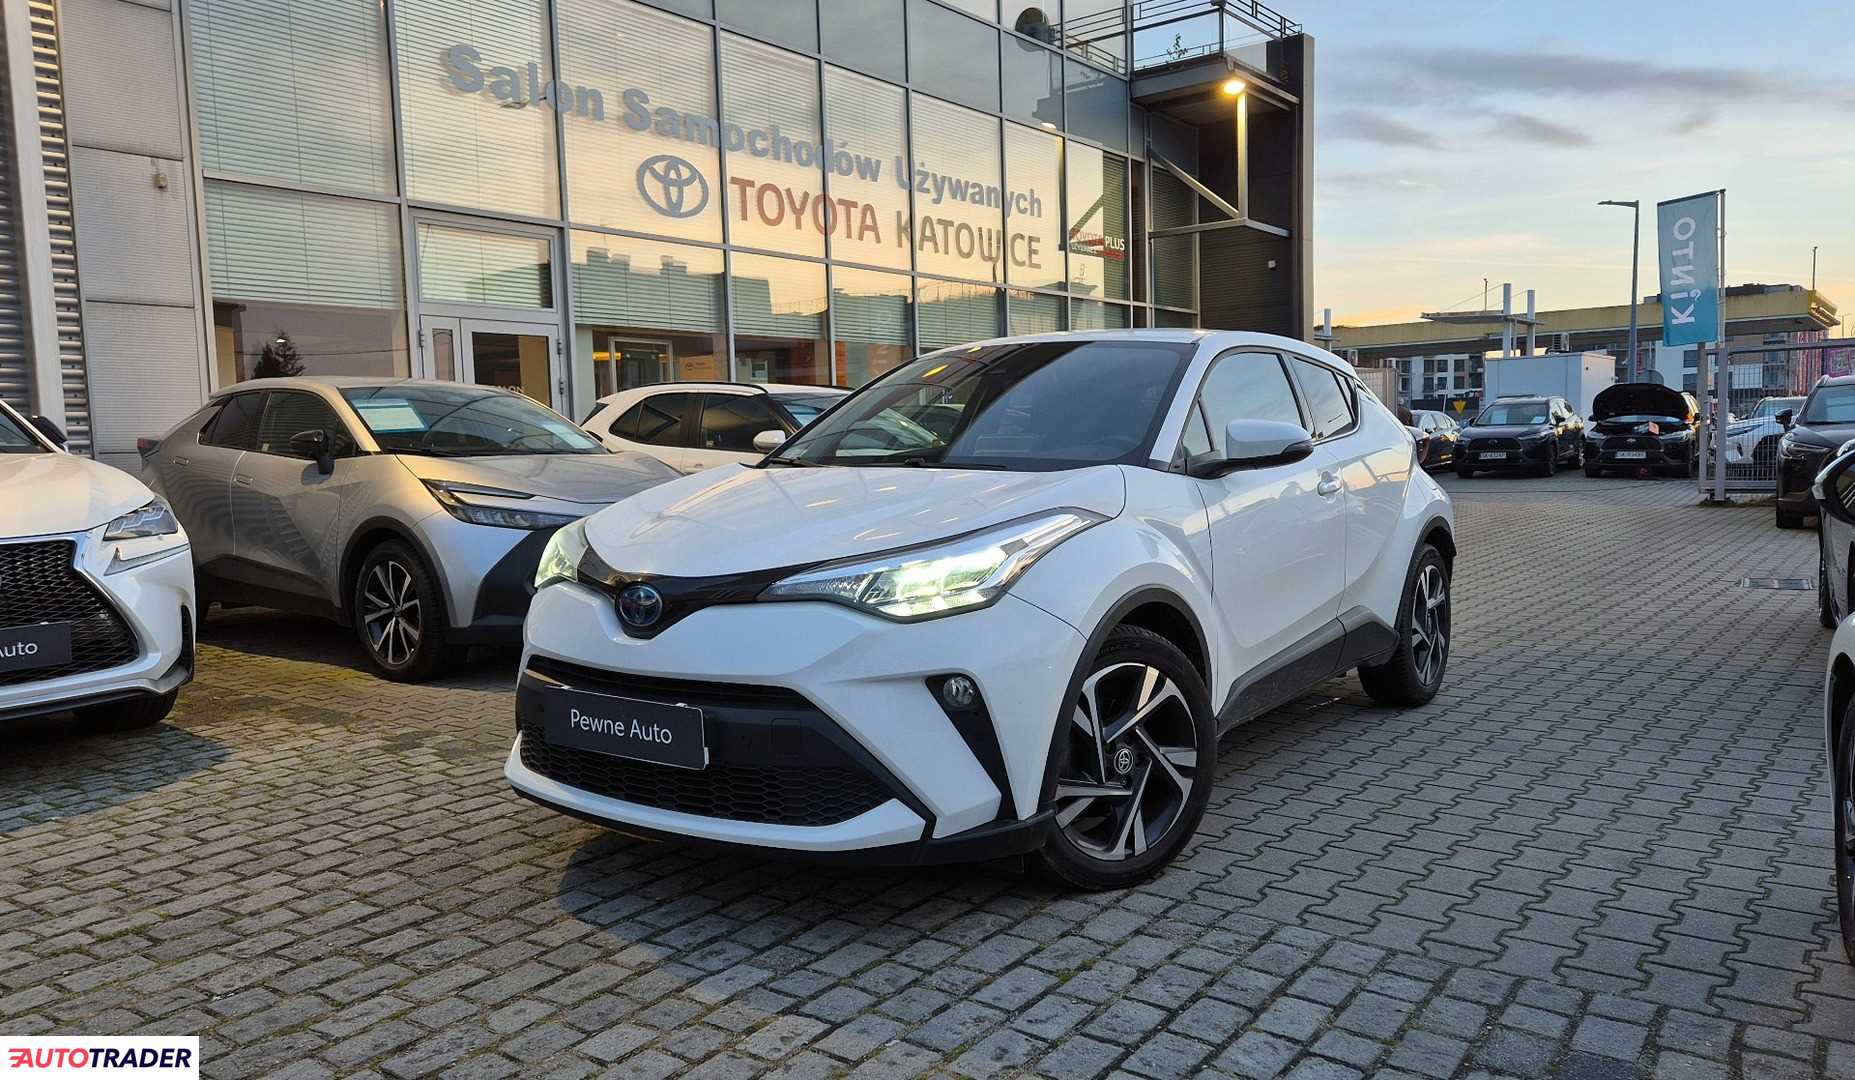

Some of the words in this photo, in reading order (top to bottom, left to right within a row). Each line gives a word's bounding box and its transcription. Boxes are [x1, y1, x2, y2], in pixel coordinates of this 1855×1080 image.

[446, 44, 605, 121] Salon
[622, 87, 882, 182] Samochodów
[895, 156, 1042, 218] Używanych
[730, 176, 882, 244] TOYOTA
[1104, 235, 1125, 251] PLUS
[570, 708, 625, 737] Pewne
[629, 719, 672, 744] Auto
